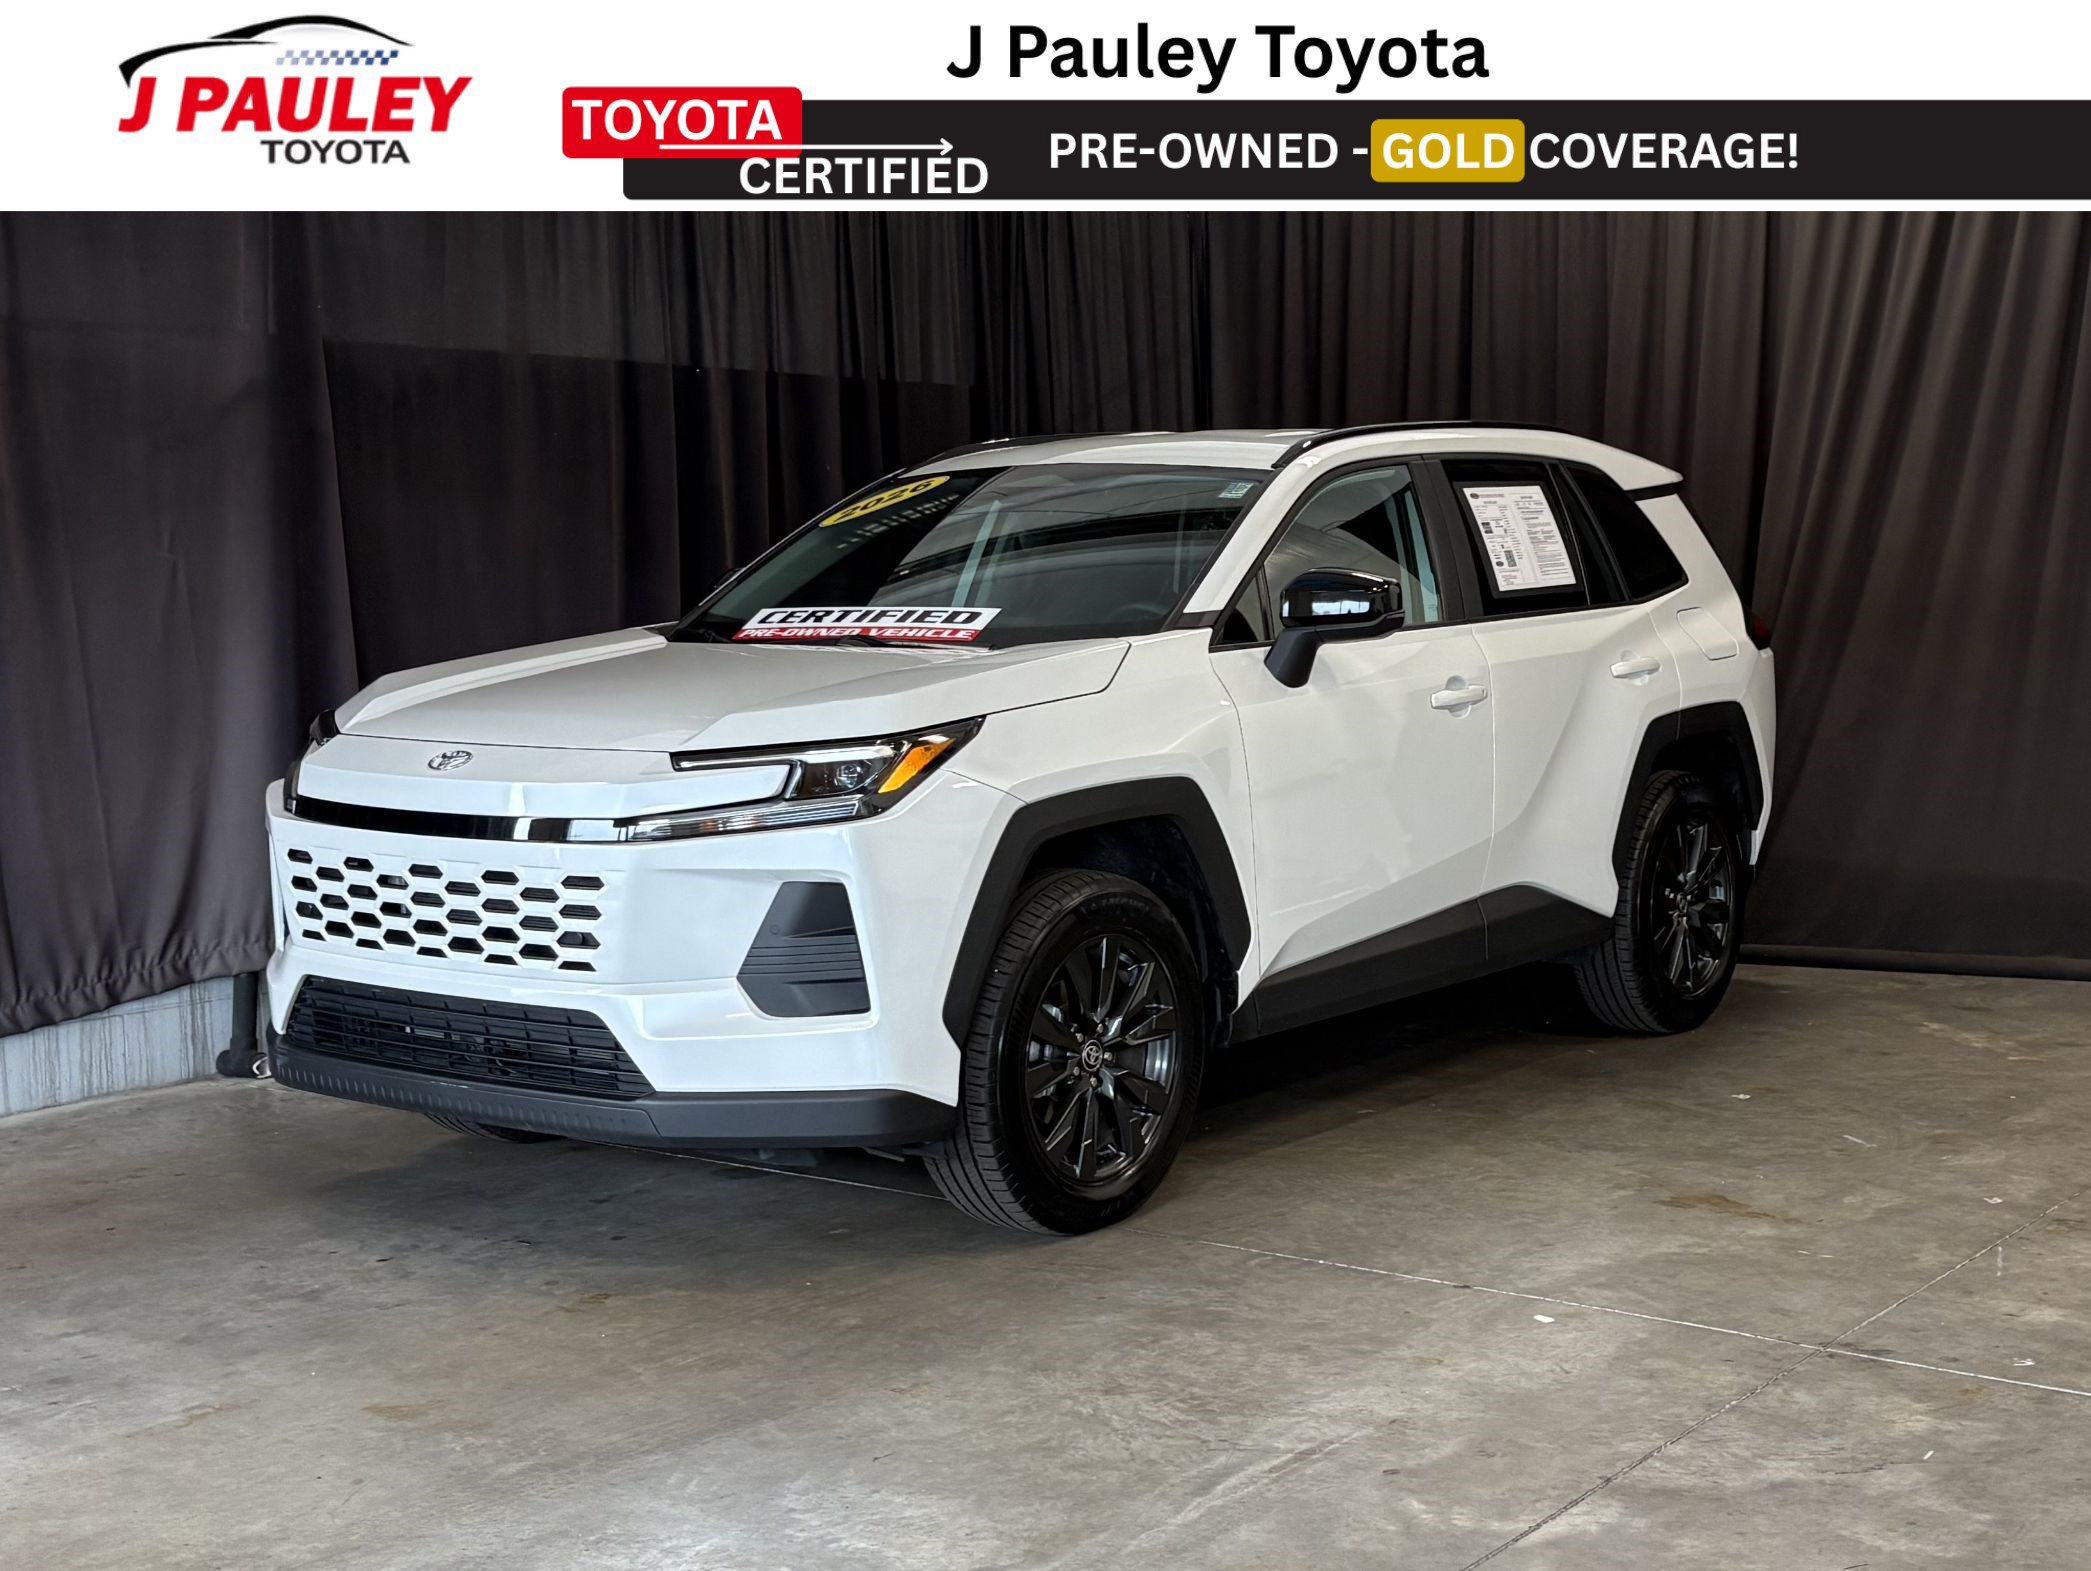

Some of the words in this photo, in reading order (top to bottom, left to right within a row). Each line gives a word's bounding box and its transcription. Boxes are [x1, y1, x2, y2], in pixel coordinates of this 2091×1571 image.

[833, 479, 936, 523] 2026
[757, 610, 984, 625] CERTIFIED
[739, 628, 864, 638] PRE-OWNED
[867, 628, 976, 639] VEHICLE
